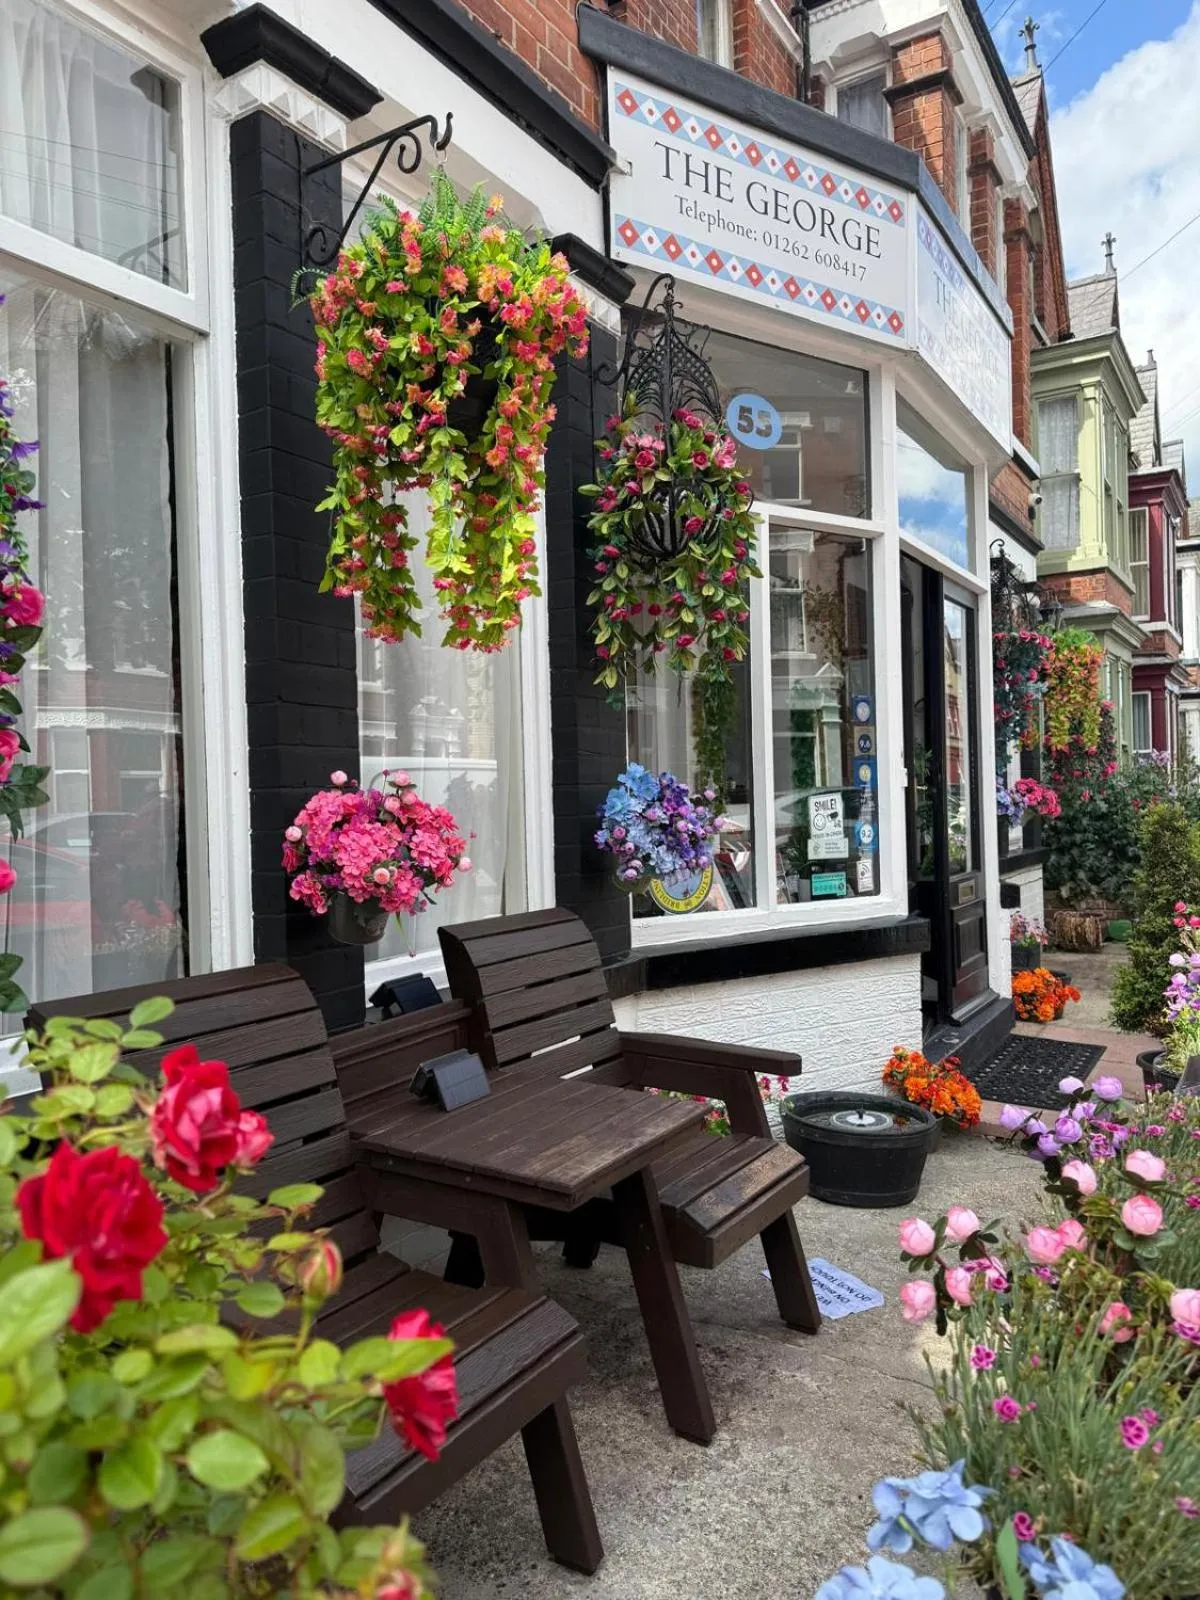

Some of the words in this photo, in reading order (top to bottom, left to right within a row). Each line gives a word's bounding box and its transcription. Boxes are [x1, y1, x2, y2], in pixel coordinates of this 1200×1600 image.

[654, 141, 735, 204] THE
[746, 181, 882, 259] GEORGE
[674, 194, 758, 241] Telephone:
[762, 231, 809, 260] 01262
[815, 248, 867, 282] 608417
[932, 268, 958, 330] THE
[737, 405, 773, 438] 55
[833, 1293, 850, 1304] ON
[836, 1281, 856, 1294] NOT
